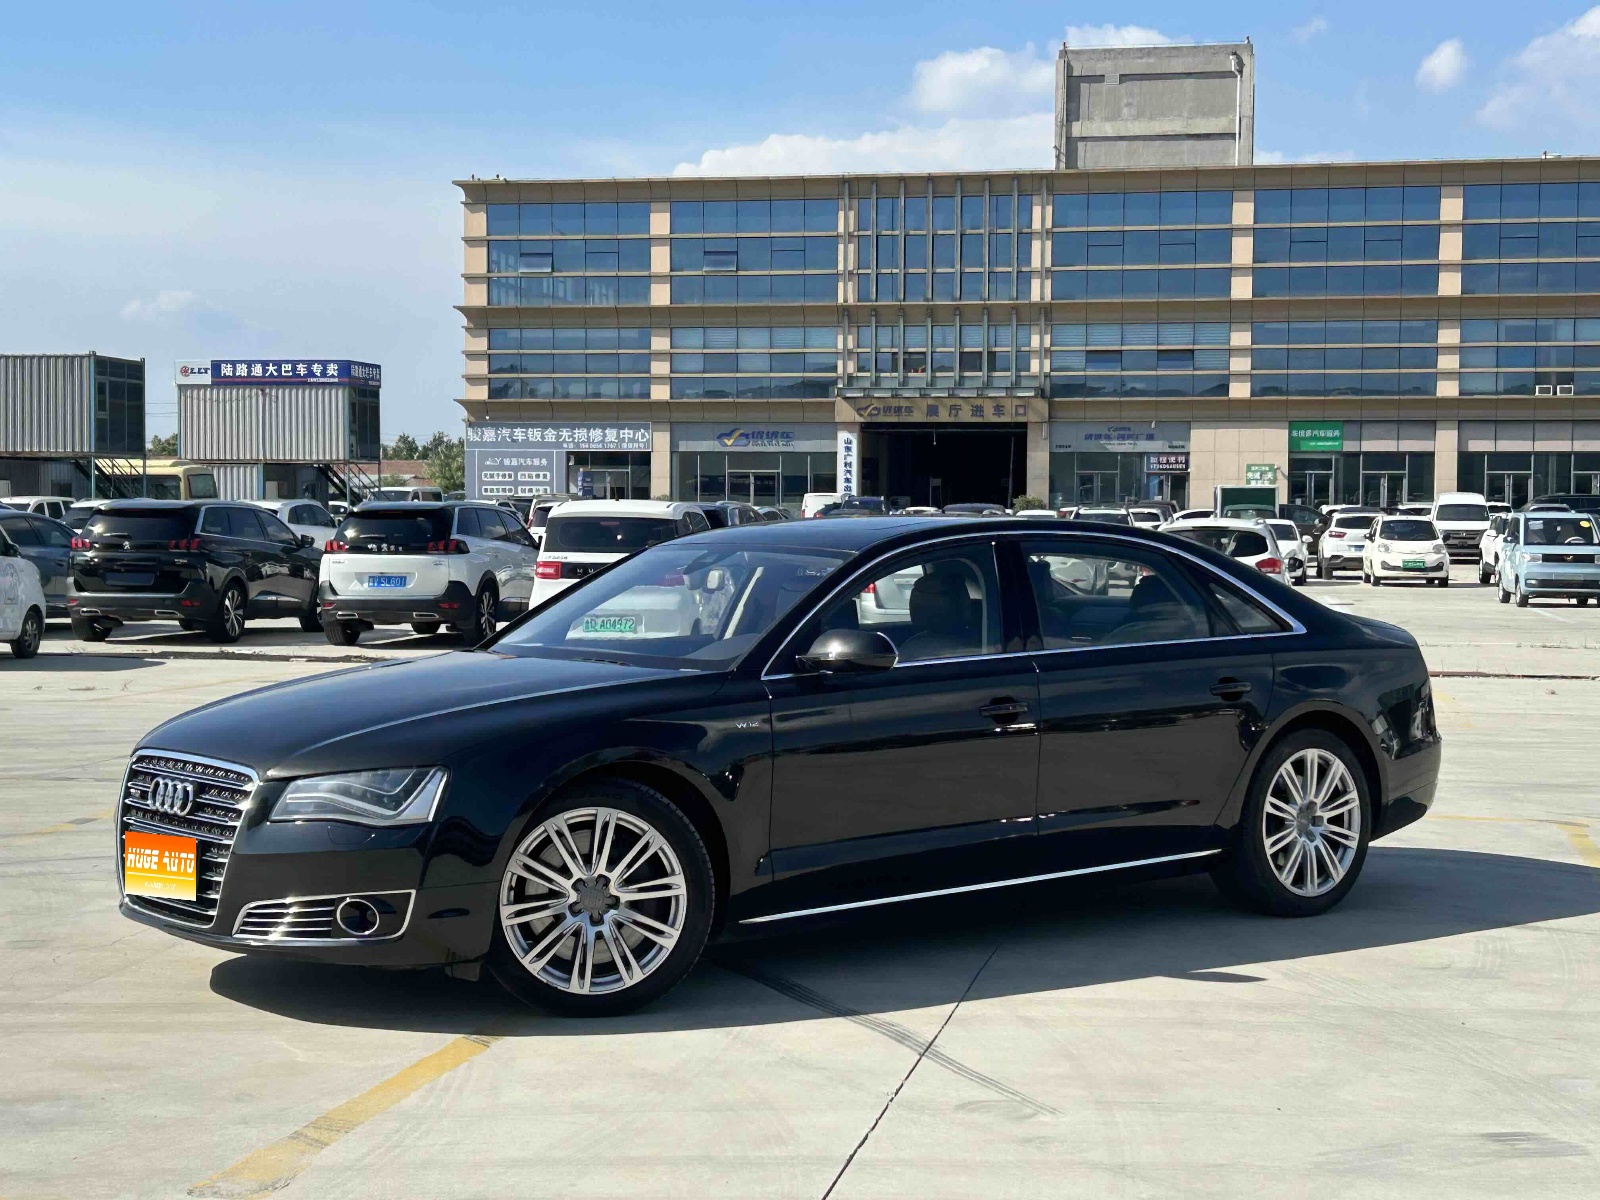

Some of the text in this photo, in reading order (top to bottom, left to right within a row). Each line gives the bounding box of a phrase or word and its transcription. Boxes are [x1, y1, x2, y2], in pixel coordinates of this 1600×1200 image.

[220, 363, 339, 377] 陆路通大巴车专卖
[467, 427, 650, 443] 骏嘉汽车钣金无损修复中心
[735, 721, 760, 729] W12
